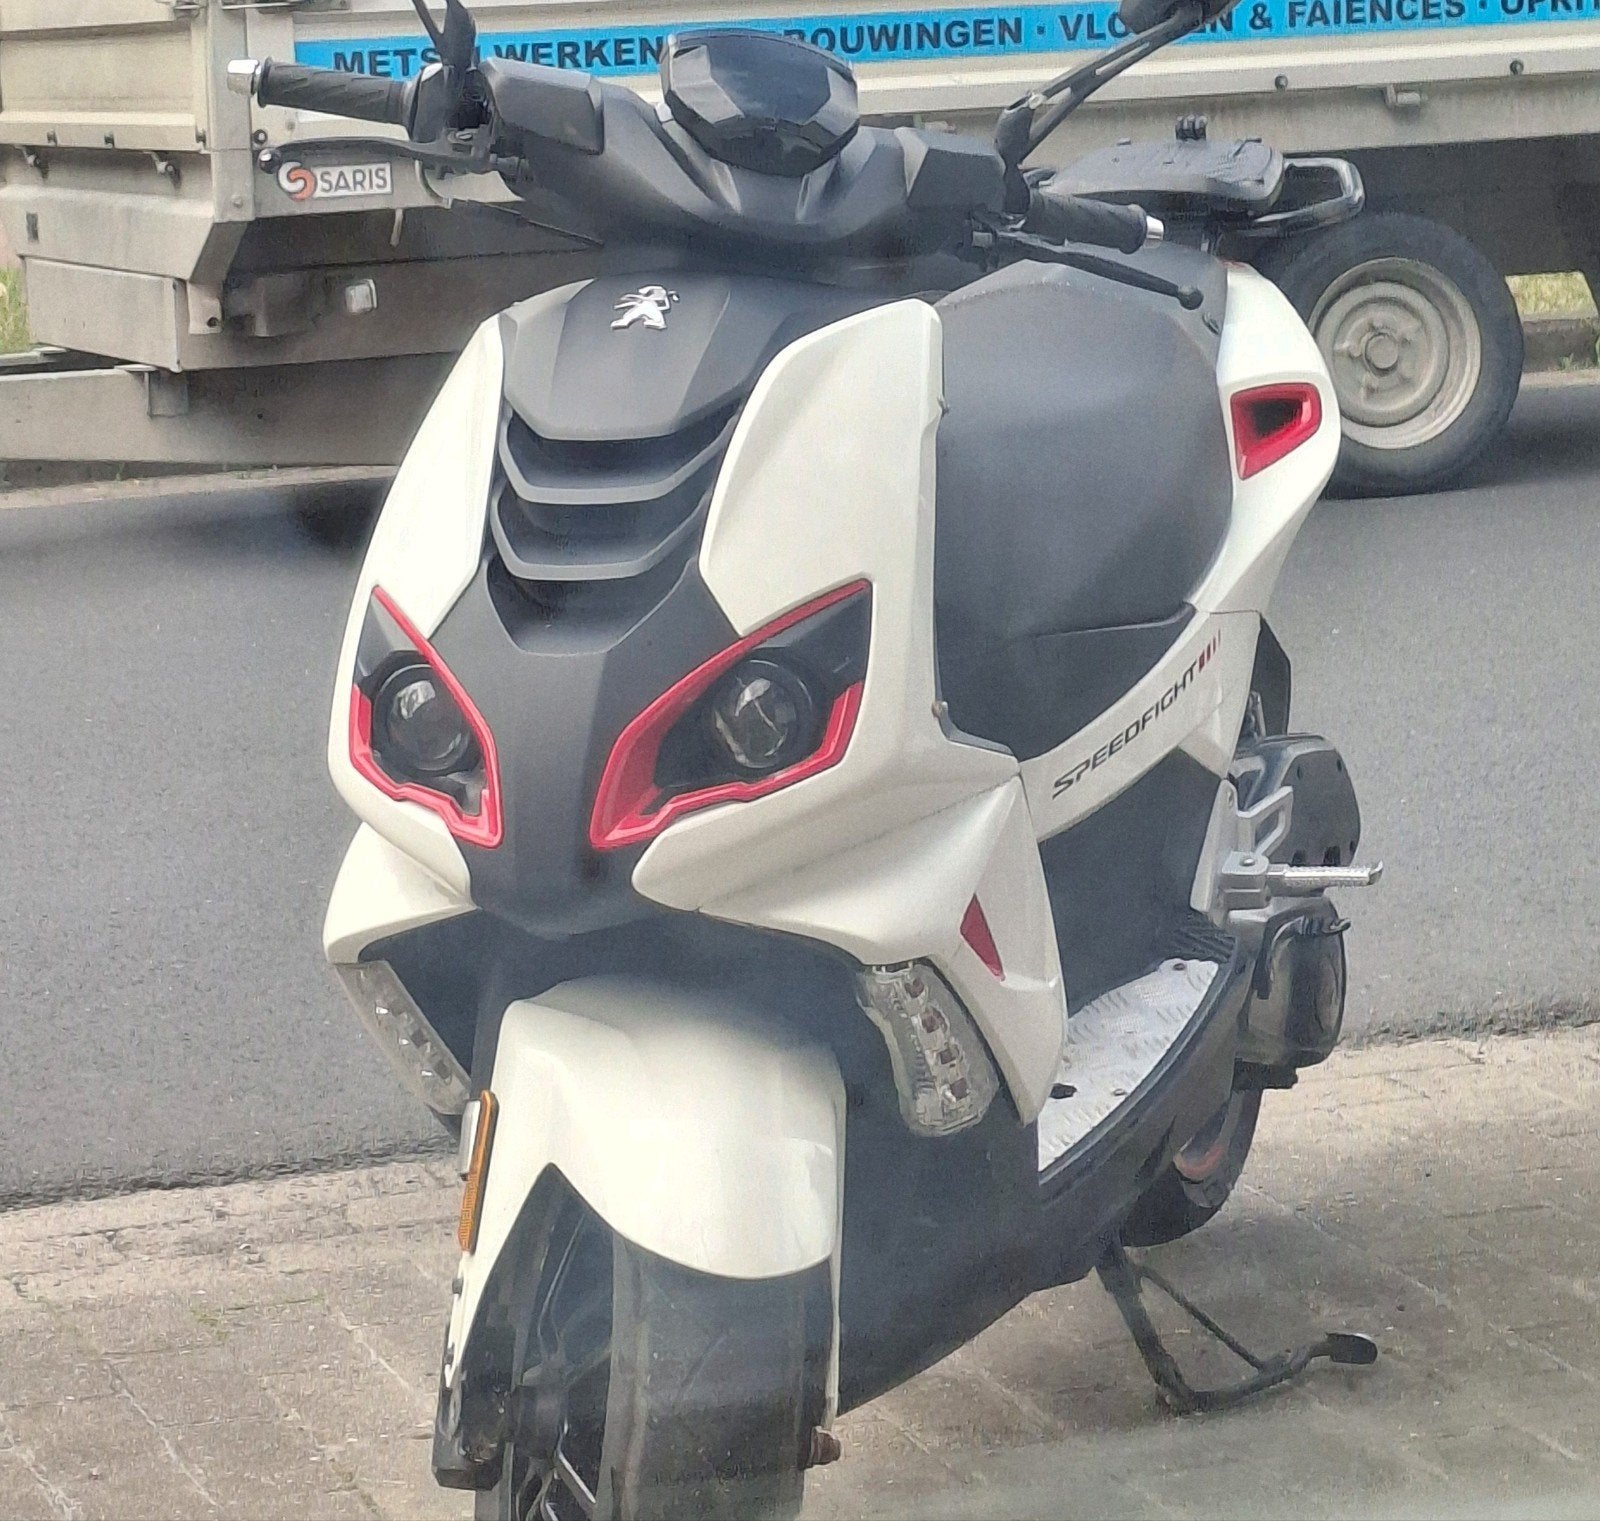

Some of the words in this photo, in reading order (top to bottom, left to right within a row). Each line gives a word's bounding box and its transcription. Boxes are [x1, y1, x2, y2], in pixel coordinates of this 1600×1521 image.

[1249, 4, 1272, 30] &
[1288, 0, 1466, 28] FAIENCES
[319, 167, 388, 193] SARIS
[1052, 659, 1197, 800] SPEEDFIGHT
